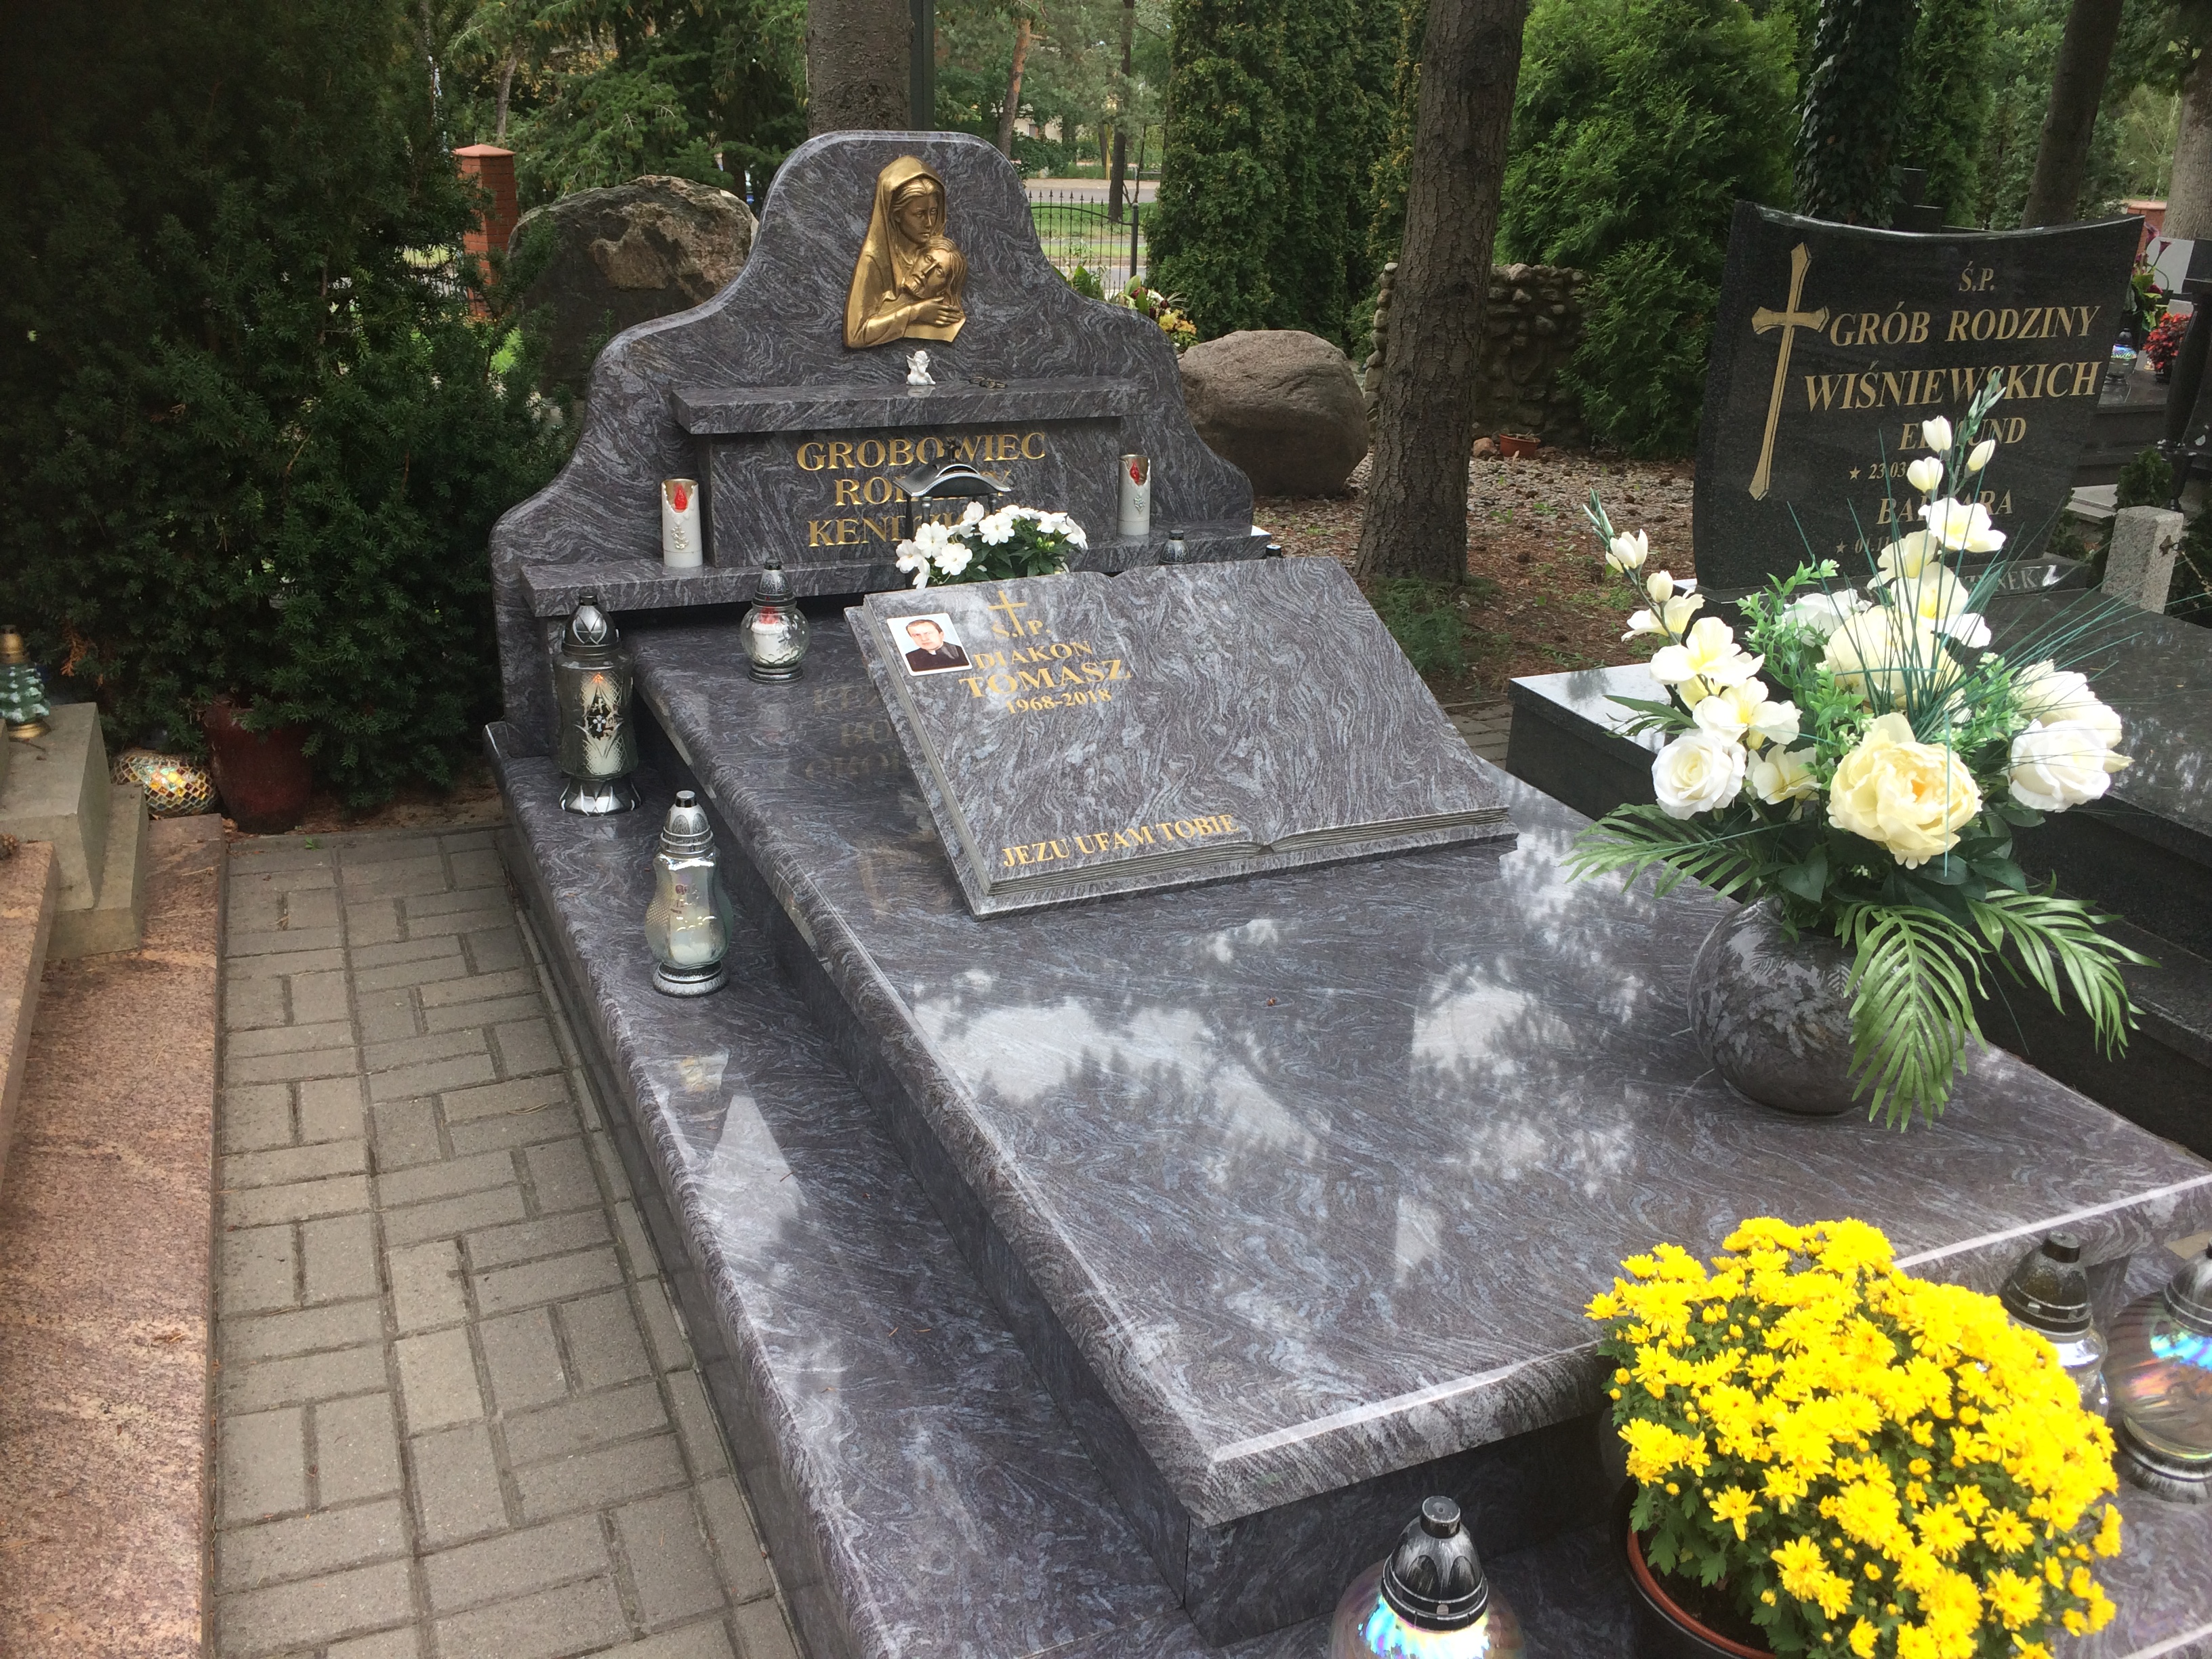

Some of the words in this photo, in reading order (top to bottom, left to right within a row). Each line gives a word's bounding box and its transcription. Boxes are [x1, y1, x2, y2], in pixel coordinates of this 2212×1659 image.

[1830, 300, 1931, 346] GRÓB
[1944, 305, 2101, 342] RODZINY
[796, 432, 1046, 471] GROBOWIEC
[1898, 417, 2027, 451] EUND
[973, 640, 1094, 670] DIAKON
[958, 659, 1132, 699] TOMASZ
[1005, 688, 1113, 715] 1968-2018
[1002, 838, 1071, 867] JEZU
[1076, 825, 1156, 855] UFAM
[1154, 813, 1240, 842] TOBIE
